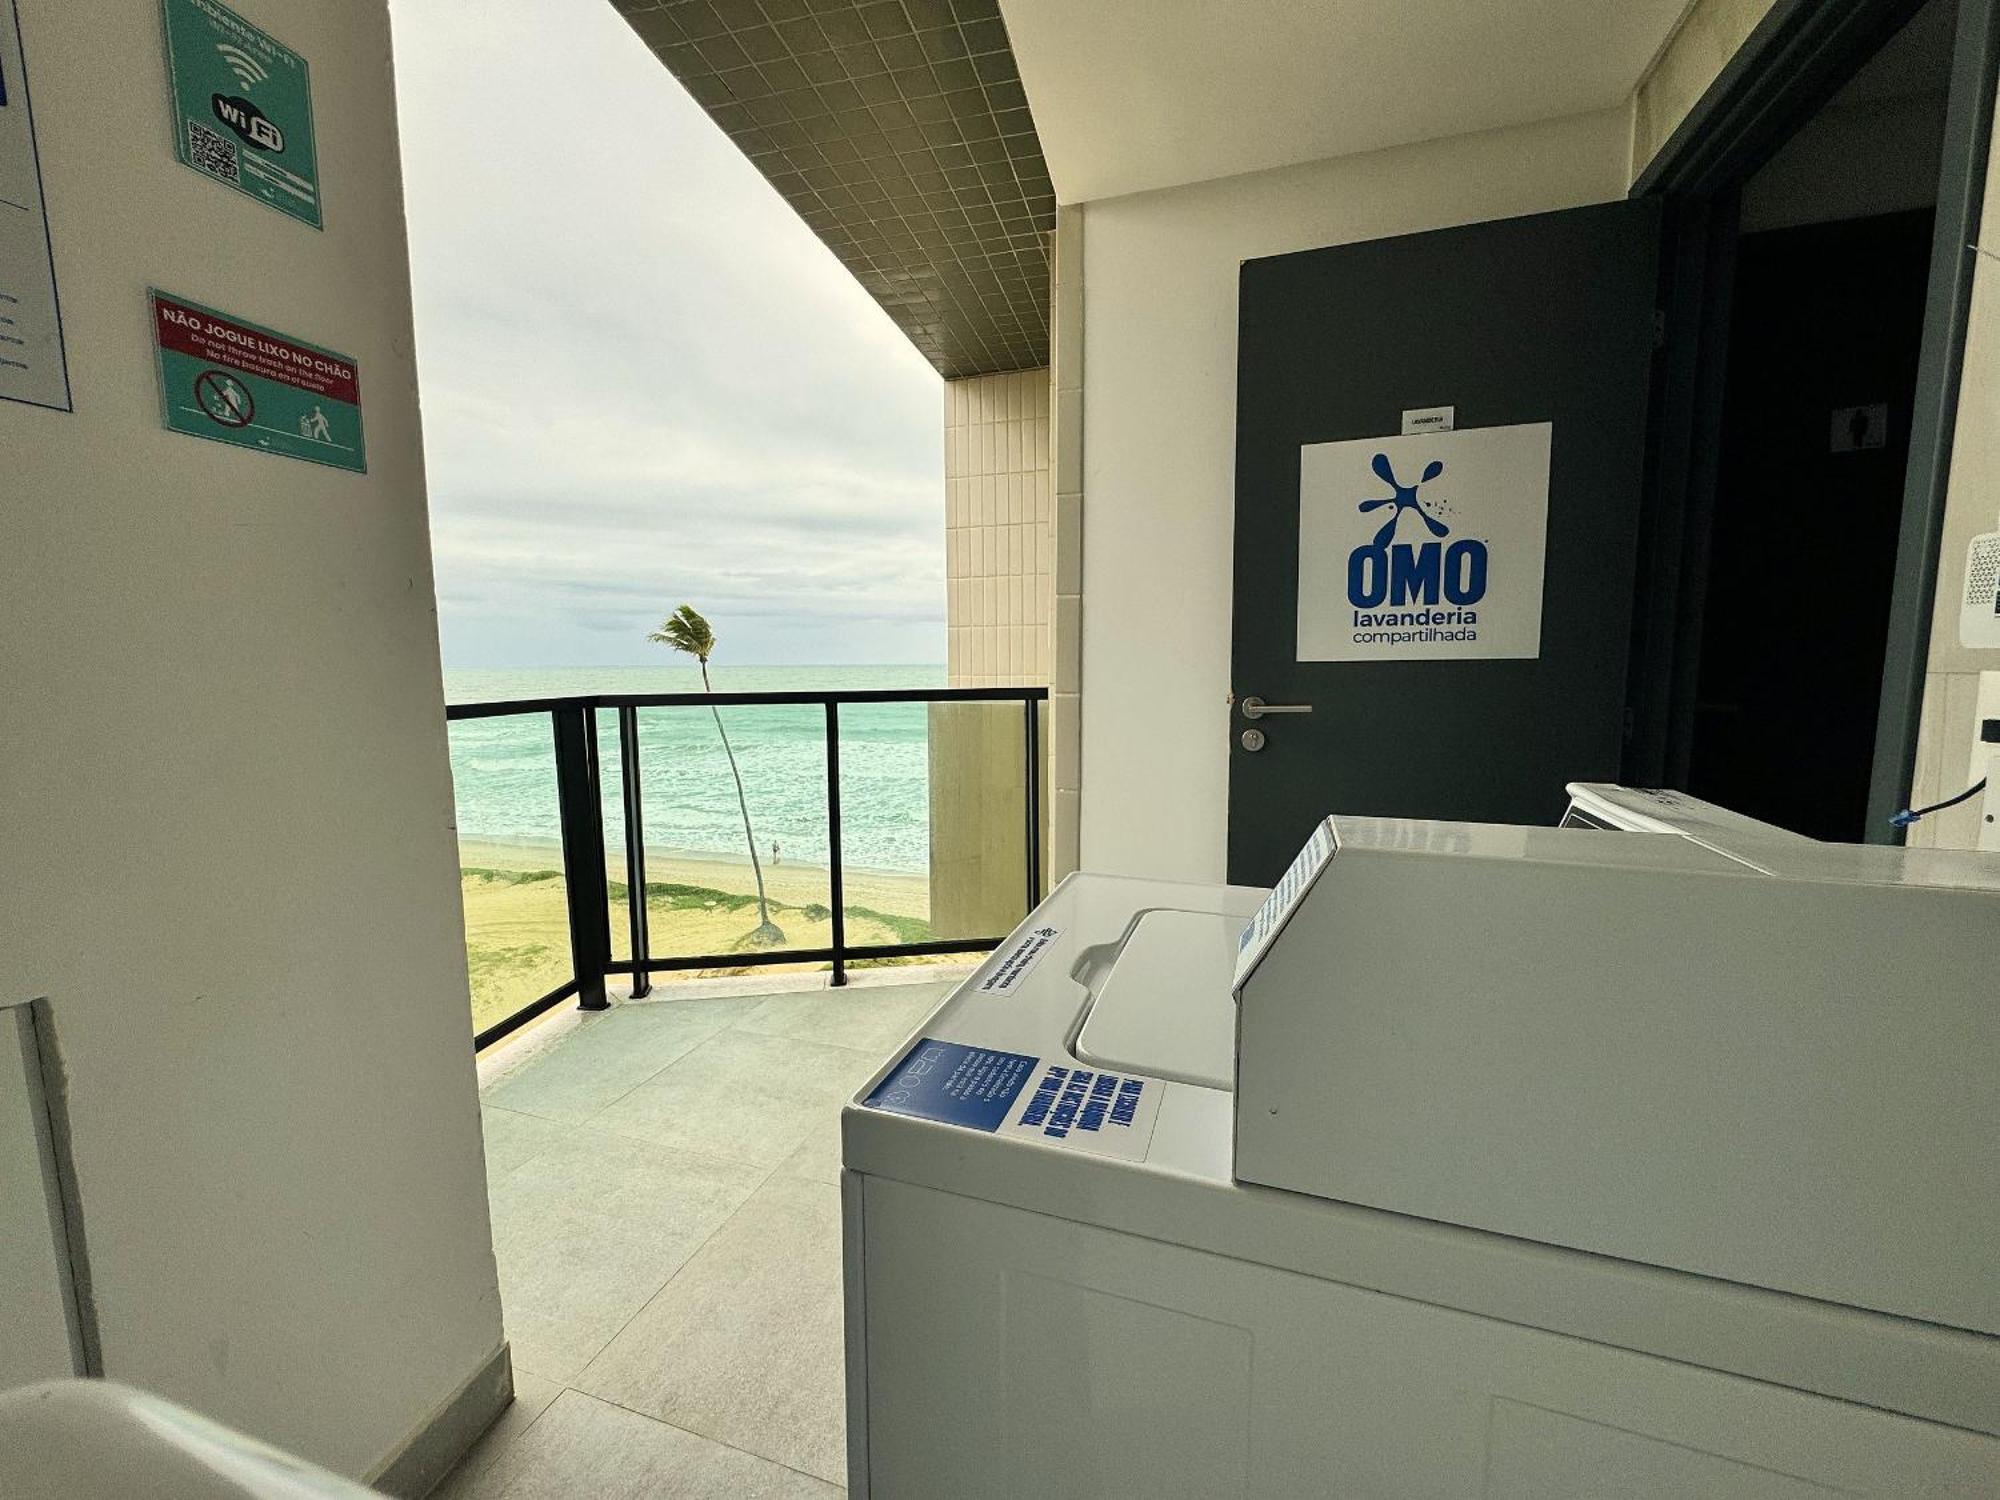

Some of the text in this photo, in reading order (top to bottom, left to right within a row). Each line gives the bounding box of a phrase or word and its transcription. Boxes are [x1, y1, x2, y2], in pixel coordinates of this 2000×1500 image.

[163, 308, 352, 380] NÃO JOGUE LIXO NO CHÃO
[191, 333, 206, 344] Do
[208, 339, 227, 351] not
[228, 343, 258, 360] throw
[259, 352, 285, 370] trash
[285, 364, 298, 375] on
[206, 349, 221, 361] No
[222, 353, 241, 368] tire
[241, 358, 278, 377] basura
[1347, 539, 1488, 609] OMO
[1353, 607, 1477, 627] lavanderia
[1353, 627, 1477, 645] compartilhada
